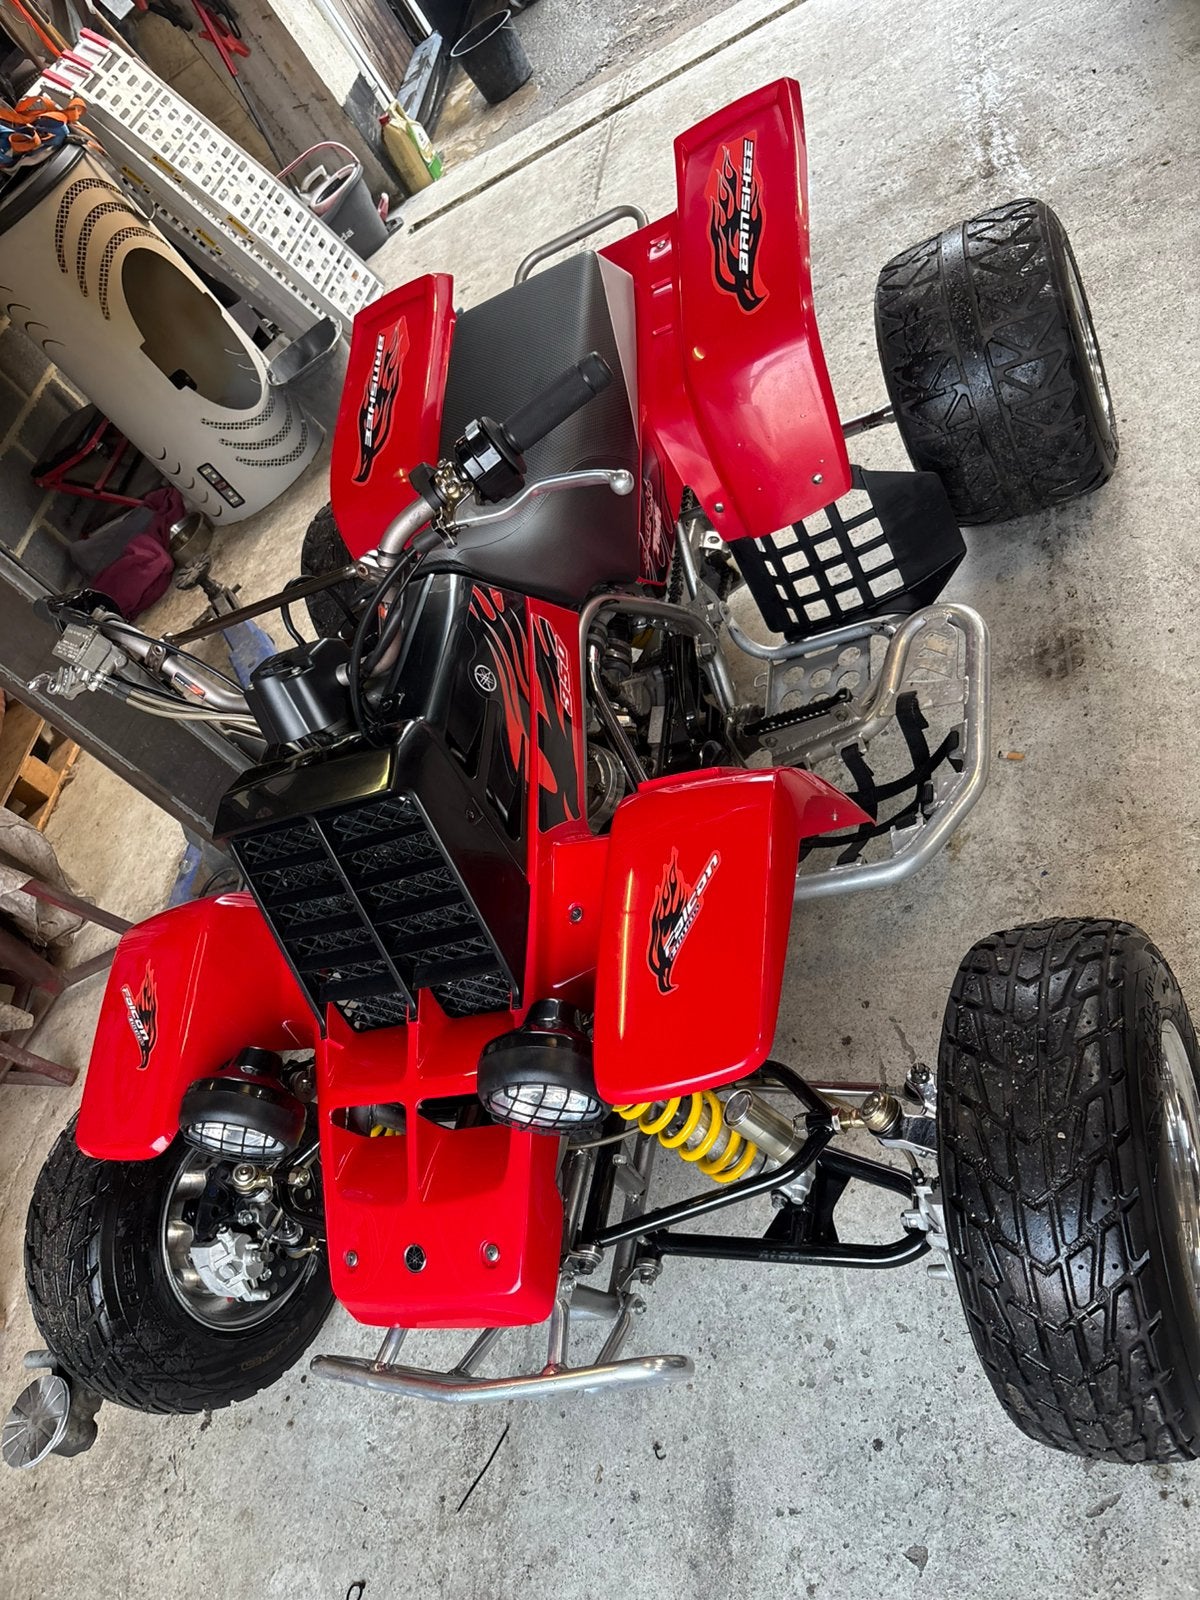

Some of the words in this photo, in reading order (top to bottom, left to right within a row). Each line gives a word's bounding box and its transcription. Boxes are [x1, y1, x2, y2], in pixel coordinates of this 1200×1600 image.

[738, 138, 754, 275] BANSHEE
[364, 333, 385, 448] BANSHEE
[663, 854, 719, 958] Falcon
[121, 987, 149, 1041] Falcon
